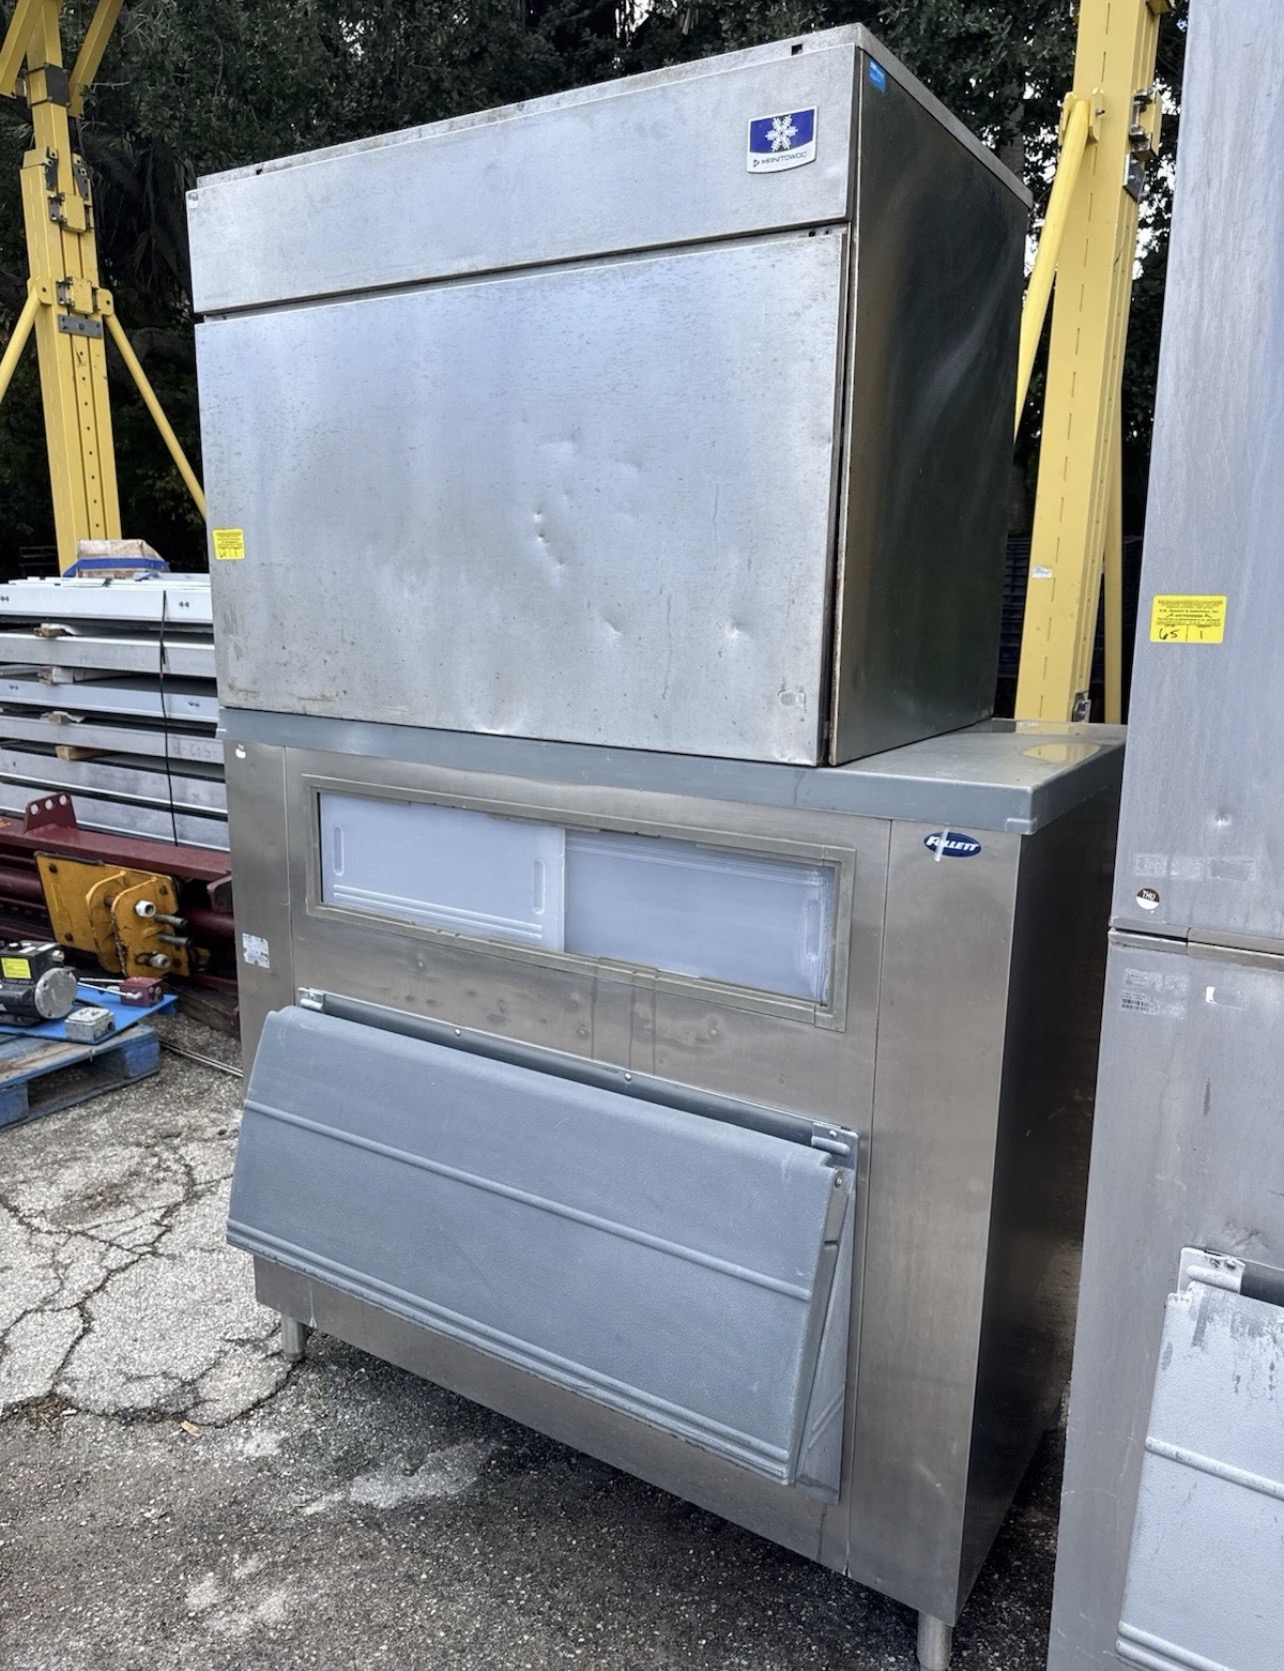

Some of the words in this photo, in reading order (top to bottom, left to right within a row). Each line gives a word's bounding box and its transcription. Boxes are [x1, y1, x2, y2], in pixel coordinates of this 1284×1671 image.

[761, 151, 807, 165] MANITOWOC
[1159, 628, 1180, 640] 65
[1142, 889, 1156, 900] THU
